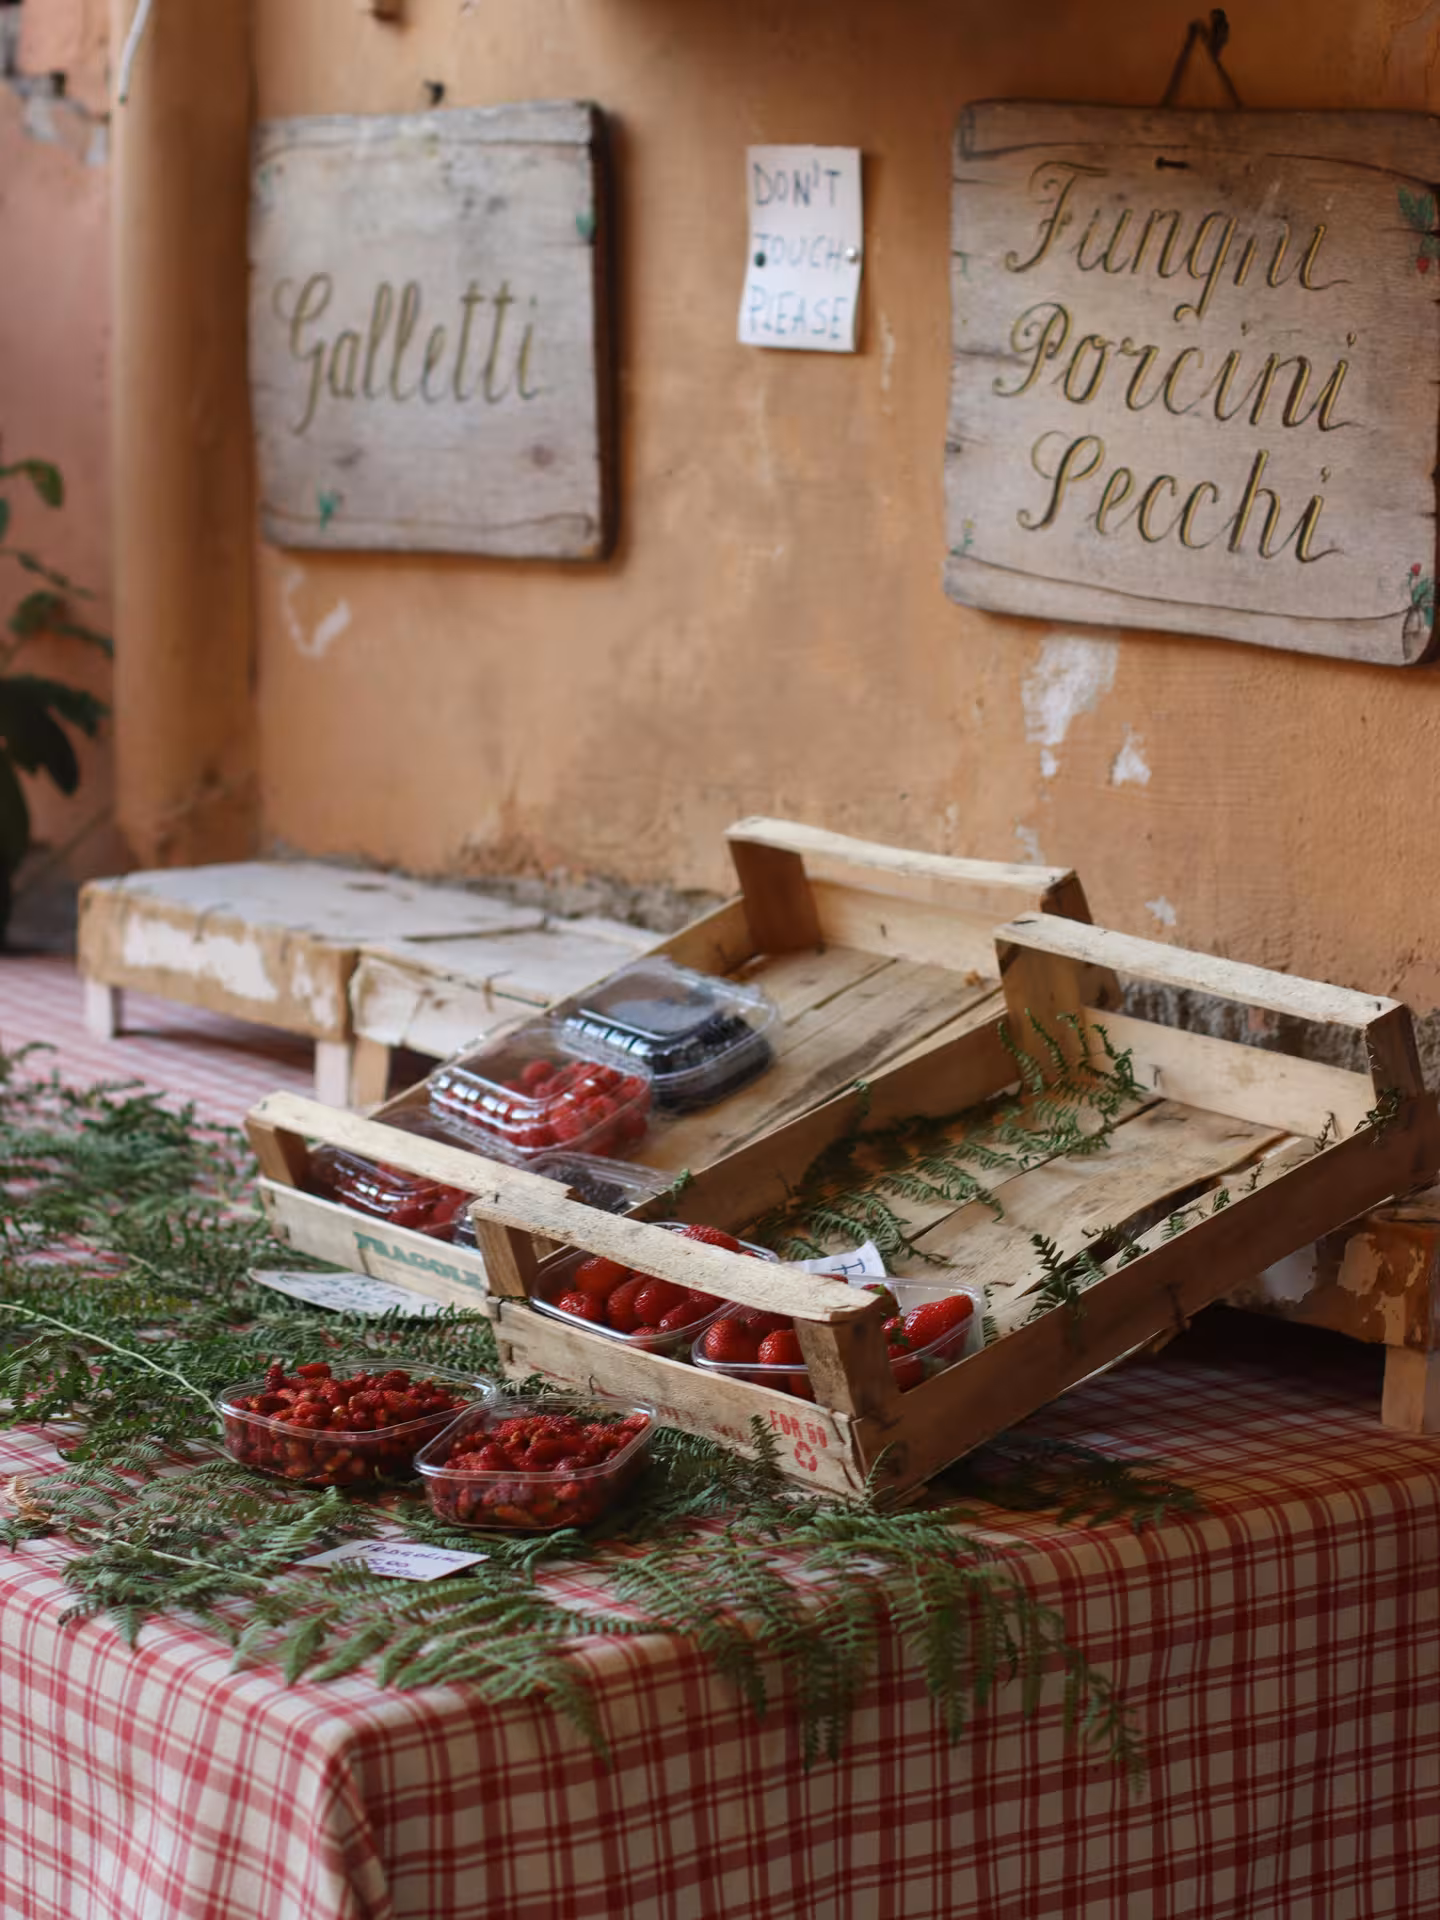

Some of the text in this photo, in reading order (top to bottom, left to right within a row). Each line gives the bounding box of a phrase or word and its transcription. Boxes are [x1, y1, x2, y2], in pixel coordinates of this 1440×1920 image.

[753, 158, 841, 208] DON'T
[755, 233, 844, 271] TOUCH
[272, 271, 541, 436] Galletti
[750, 284, 849, 340] PLEASE
[993, 302, 1362, 432] Porcini
[1016, 430, 1346, 563] Secchi
